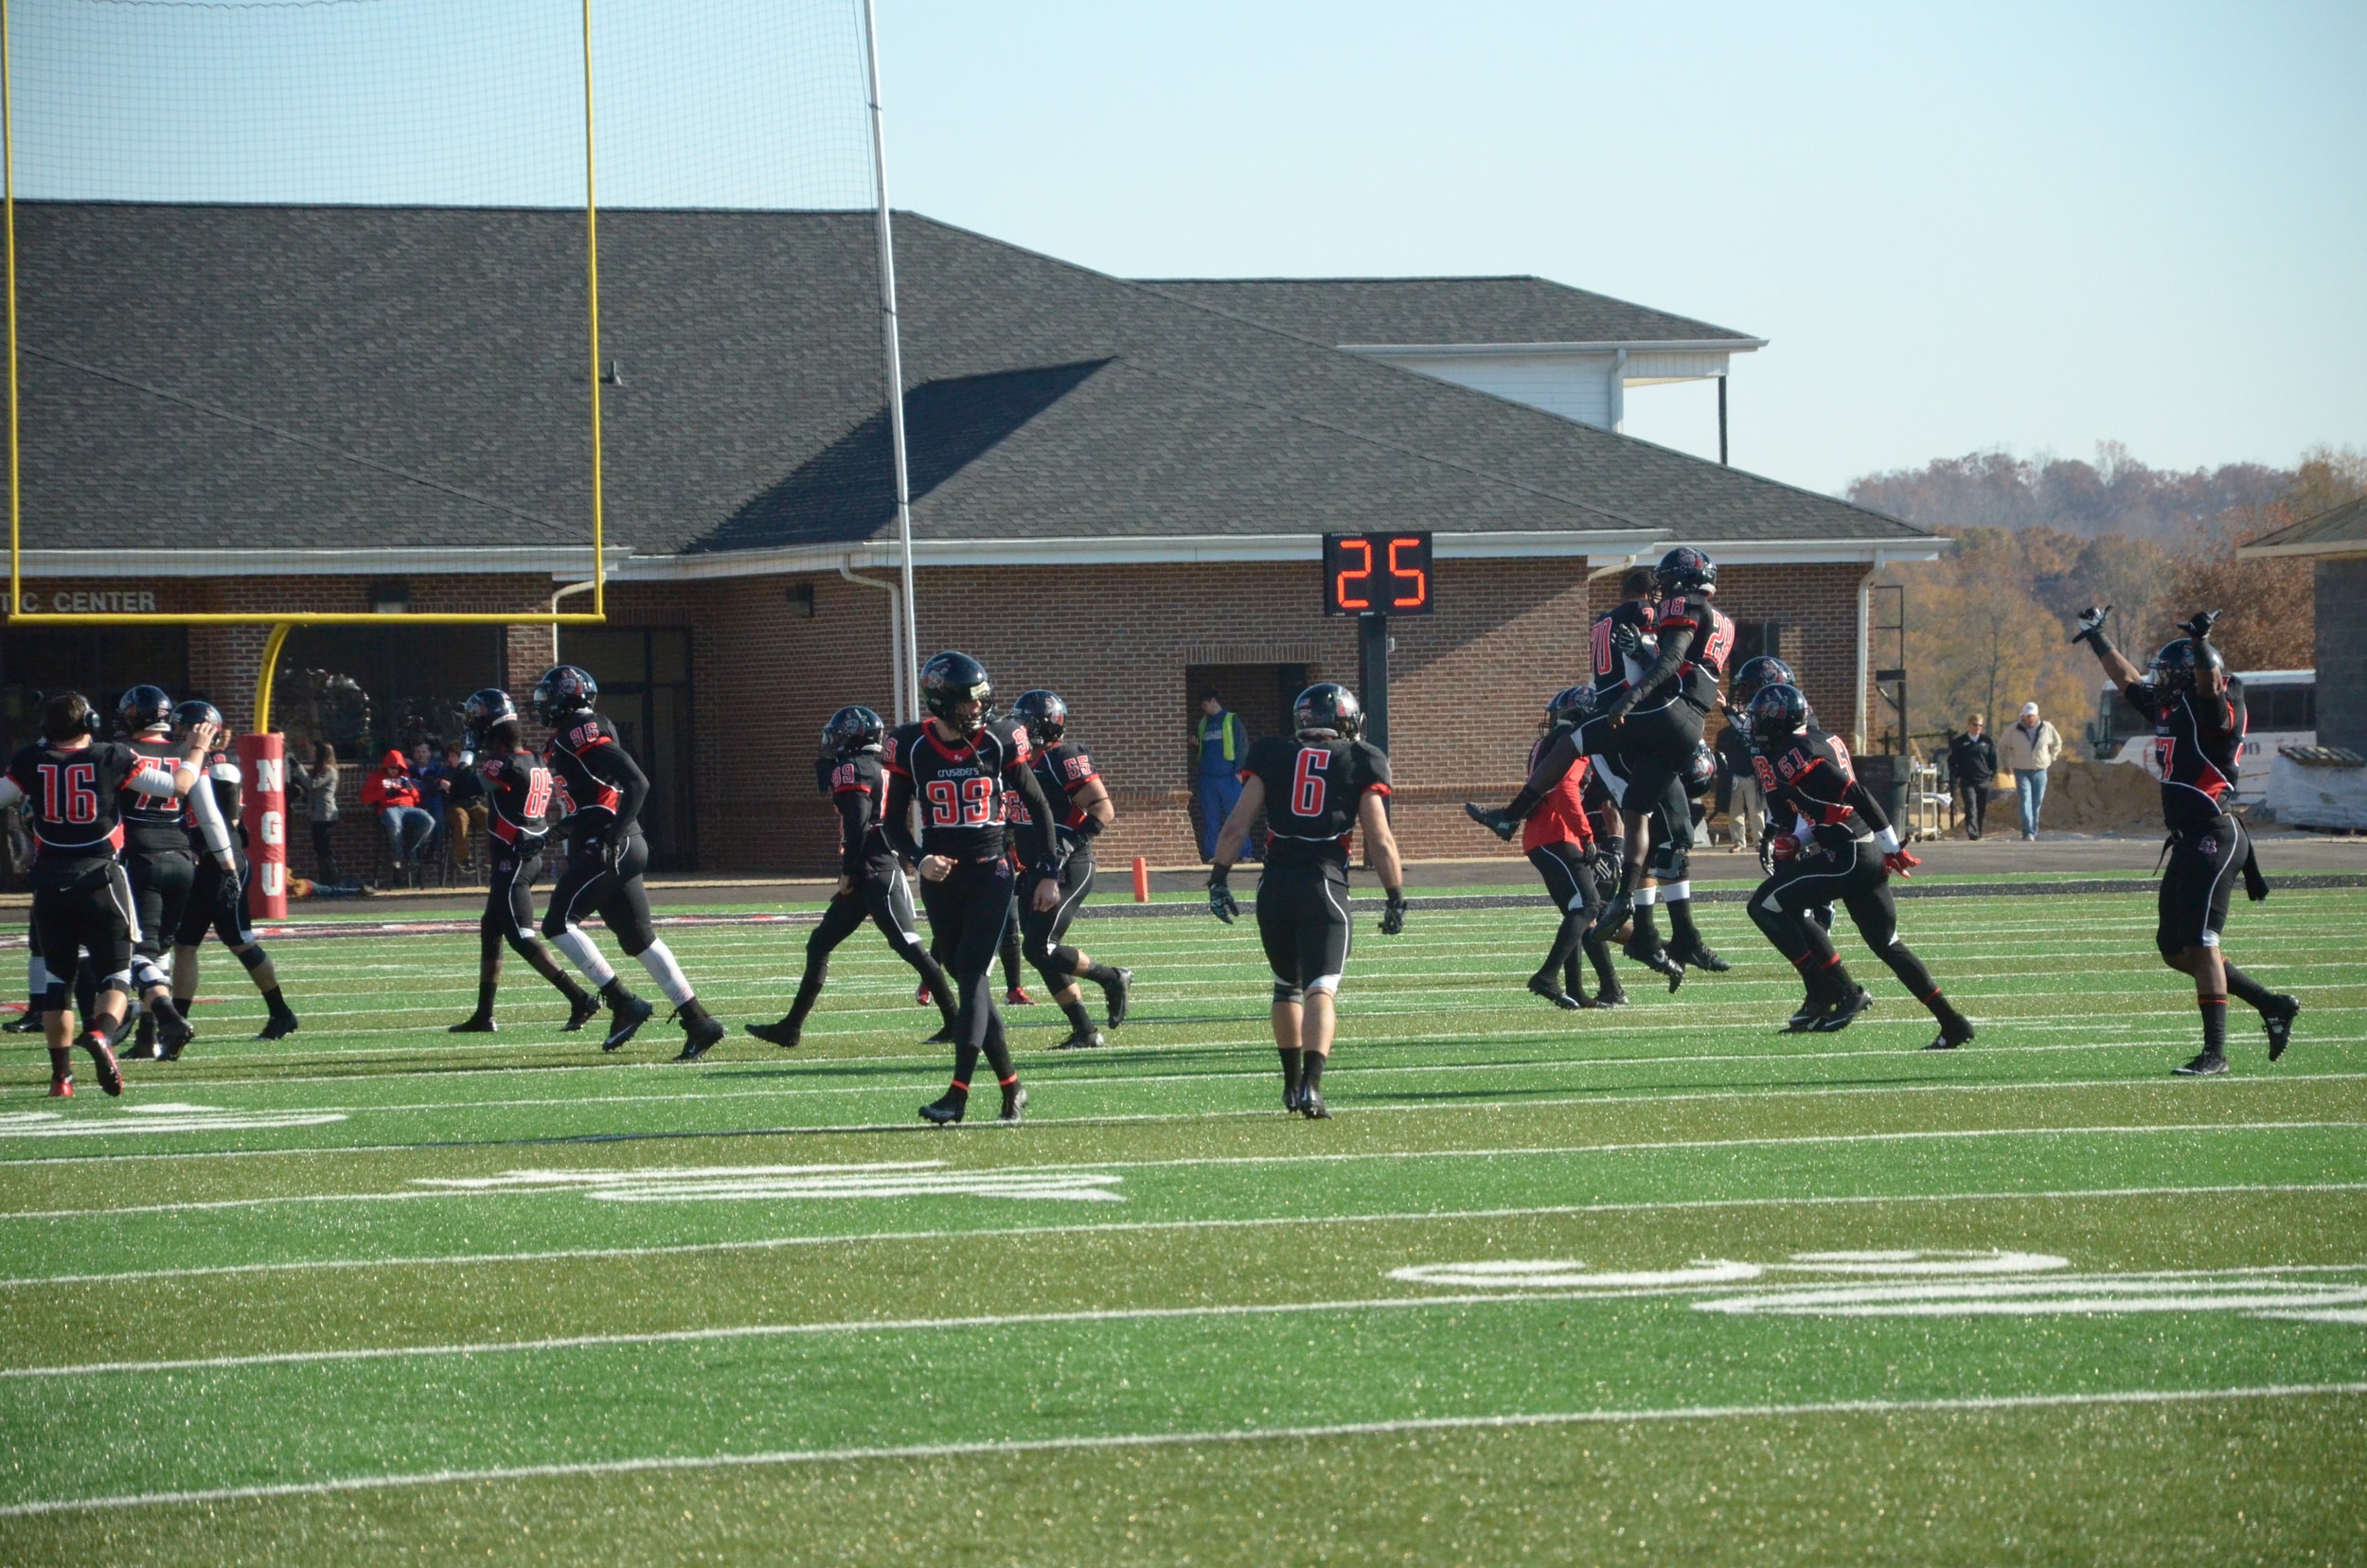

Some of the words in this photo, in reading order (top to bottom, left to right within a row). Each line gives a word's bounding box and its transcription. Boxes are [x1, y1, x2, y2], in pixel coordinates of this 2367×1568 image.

[1337, 538, 1425, 609] 25
[0, 592, 39, 612] TC
[53, 592, 156, 613] CENTER
[570, 722, 599, 748] 95
[133, 756, 181, 811] 71
[1063, 756, 1092, 779] 55
[1290, 746, 1331, 817] 6
[1778, 748, 1808, 779] 51
[37, 763, 97, 824] 16
[926, 777, 992, 825] 99
